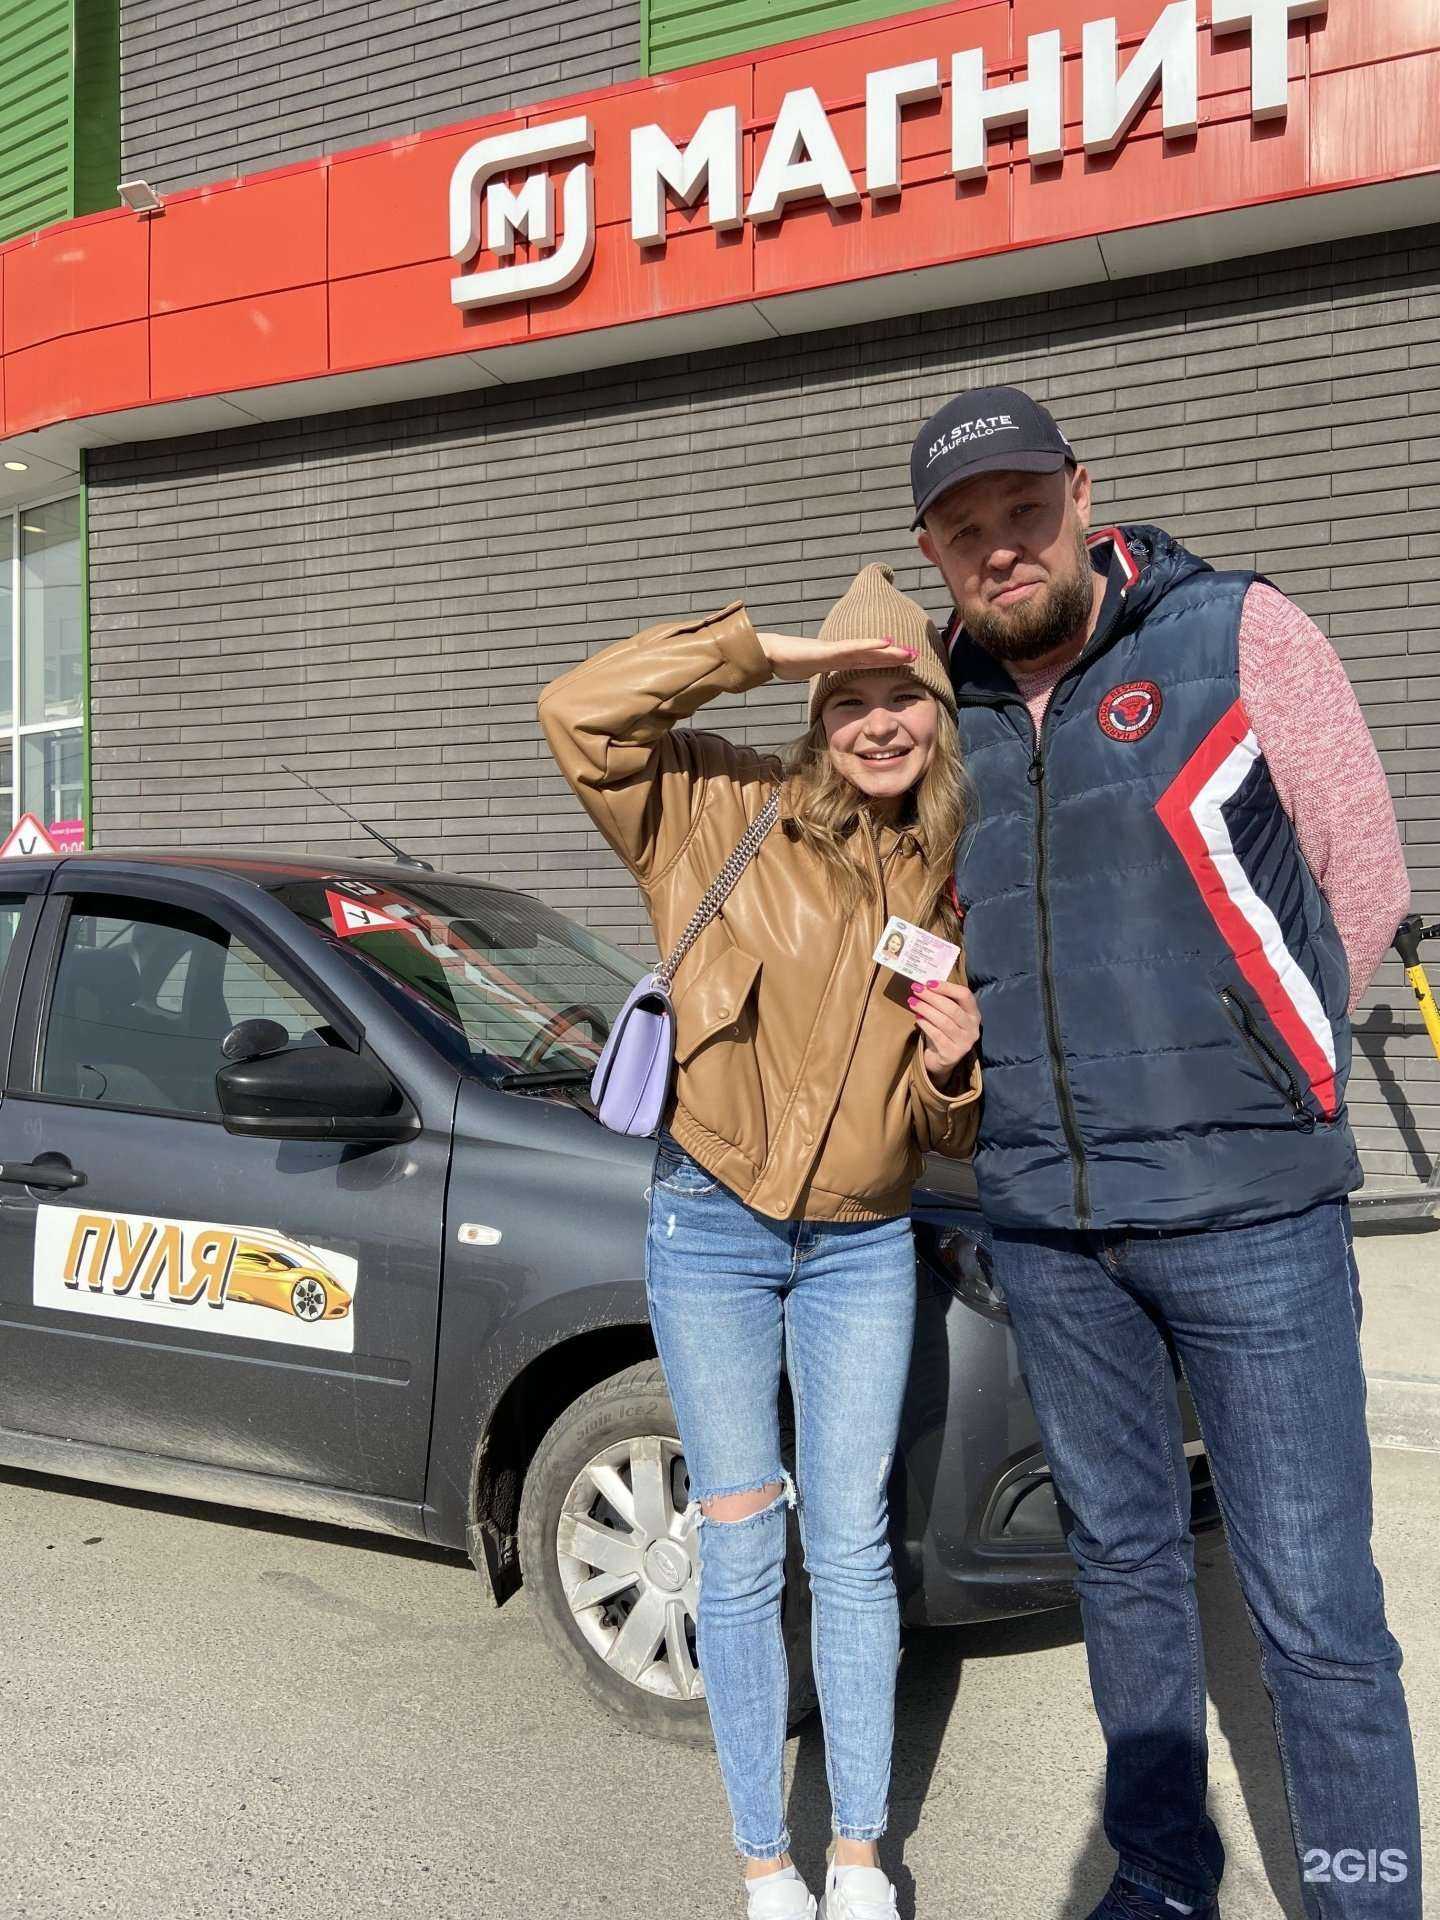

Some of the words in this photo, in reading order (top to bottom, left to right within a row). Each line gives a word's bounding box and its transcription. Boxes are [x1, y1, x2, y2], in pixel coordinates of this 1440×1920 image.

[630, 0, 1328, 248] МАГНИТ
[930, 434, 946, 457] NY
[951, 414, 1013, 440] STATE
[941, 428, 995, 455] BUFFALO
[63, 1214, 237, 1310] ПУЛЯ
